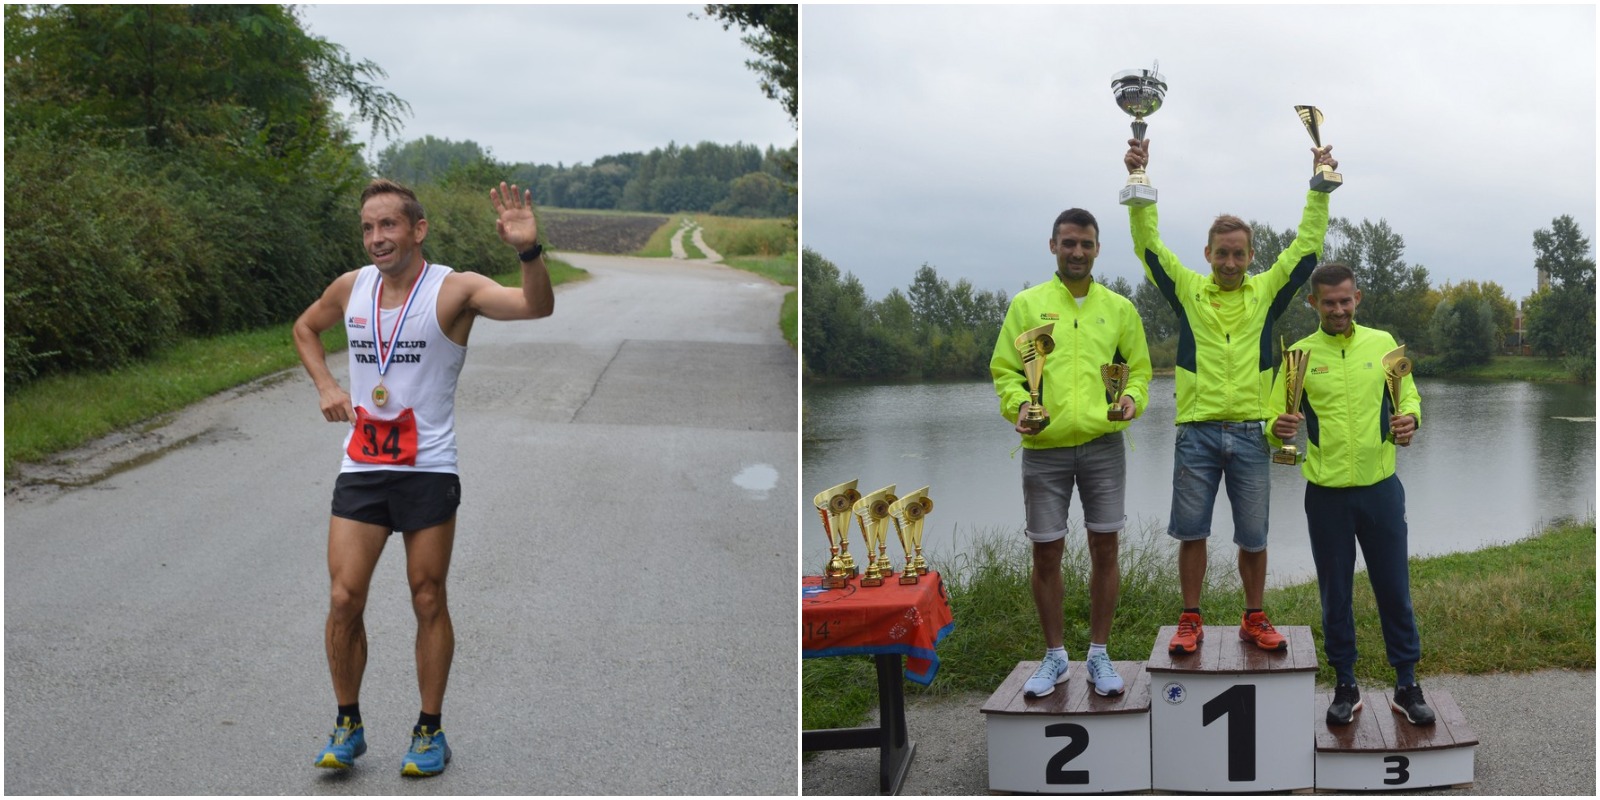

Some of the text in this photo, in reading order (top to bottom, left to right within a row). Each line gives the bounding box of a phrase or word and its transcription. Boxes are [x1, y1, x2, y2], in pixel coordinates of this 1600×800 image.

[397, 340, 426, 348] KLUB
[362, 423, 402, 460] 34
[1202, 684, 1256, 782] 1
[1044, 723, 1089, 785] 2
[1383, 755, 1410, 785] 3
